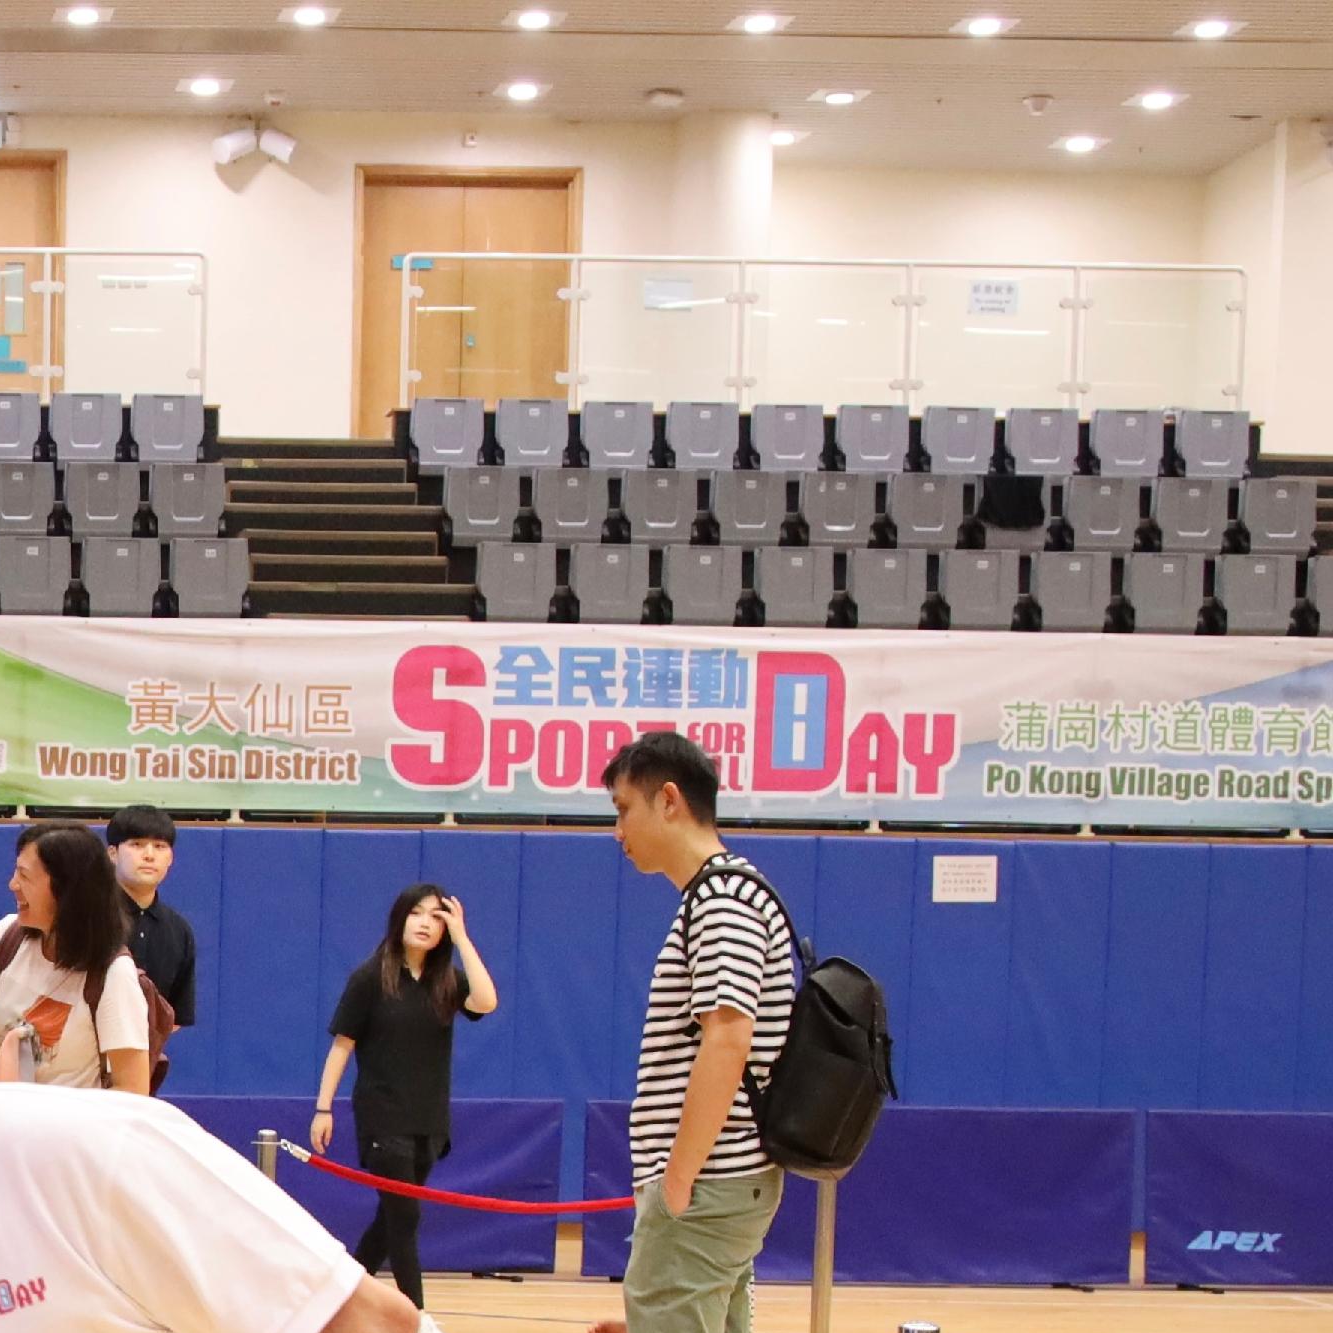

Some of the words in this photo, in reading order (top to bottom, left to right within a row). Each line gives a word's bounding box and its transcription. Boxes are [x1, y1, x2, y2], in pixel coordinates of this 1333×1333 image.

[493, 646, 749, 710] 全民運動
[128, 680, 354, 734] 黃大仙區
[751, 650, 955, 794] DAY
[38, 745, 127, 781] Wong
[135, 746, 180, 778] Tai
[187, 747, 237, 780] Sin
[244, 749, 358, 782] District
[986, 764, 1022, 794] Po
[1029, 765, 1103, 799] Kong
[1109, 766, 1209, 801] Village
[1219, 769, 1290, 799] Road
[1186, 1230, 1282, 1253] APEX
